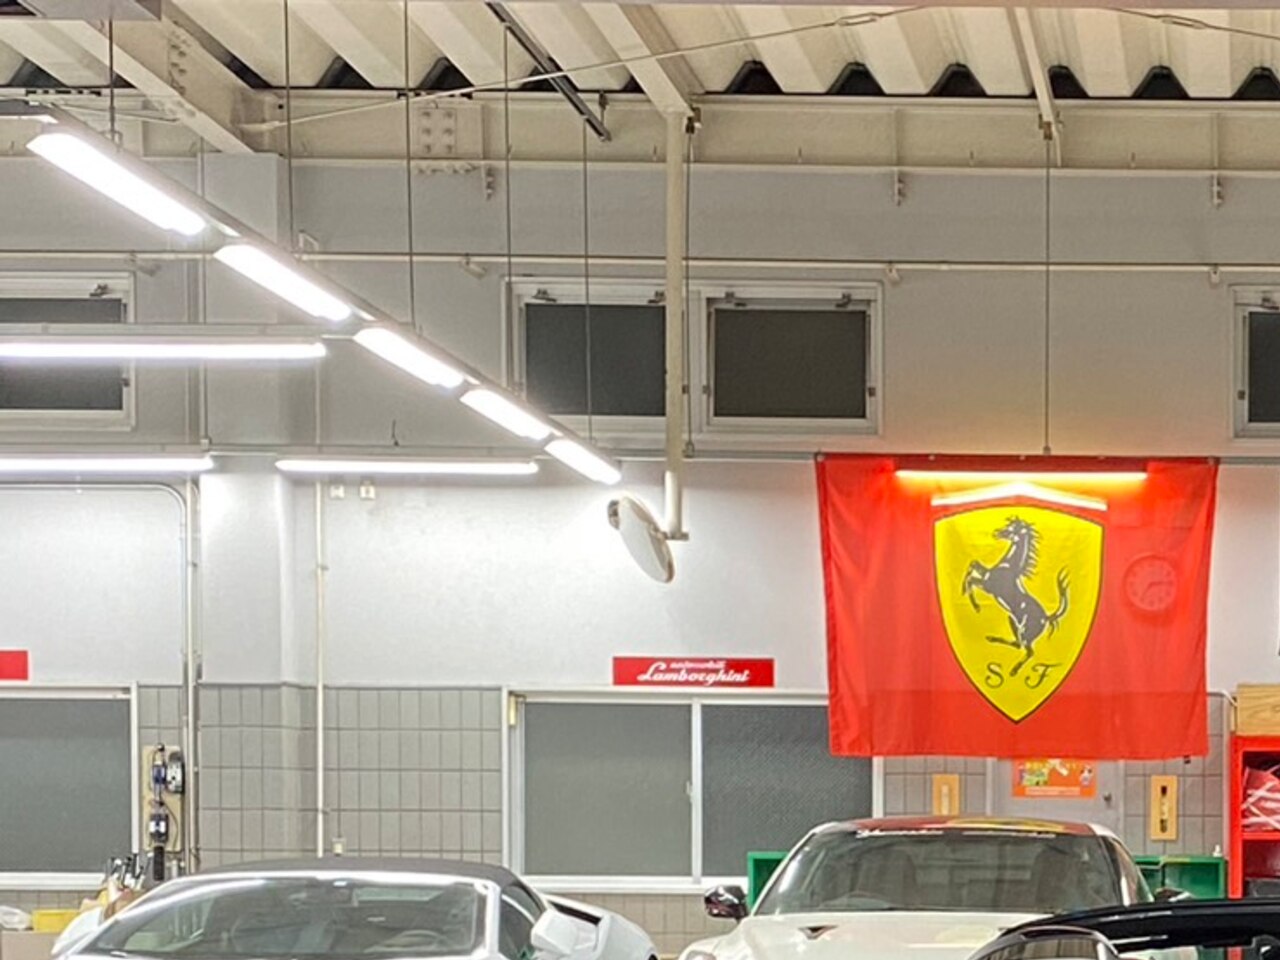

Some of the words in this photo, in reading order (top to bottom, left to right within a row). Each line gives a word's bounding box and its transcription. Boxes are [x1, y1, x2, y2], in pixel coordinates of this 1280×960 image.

[636, 660, 750, 686] Lamborghini
[985, 662, 1005, 689] S
[1024, 662, 1063, 689] F
